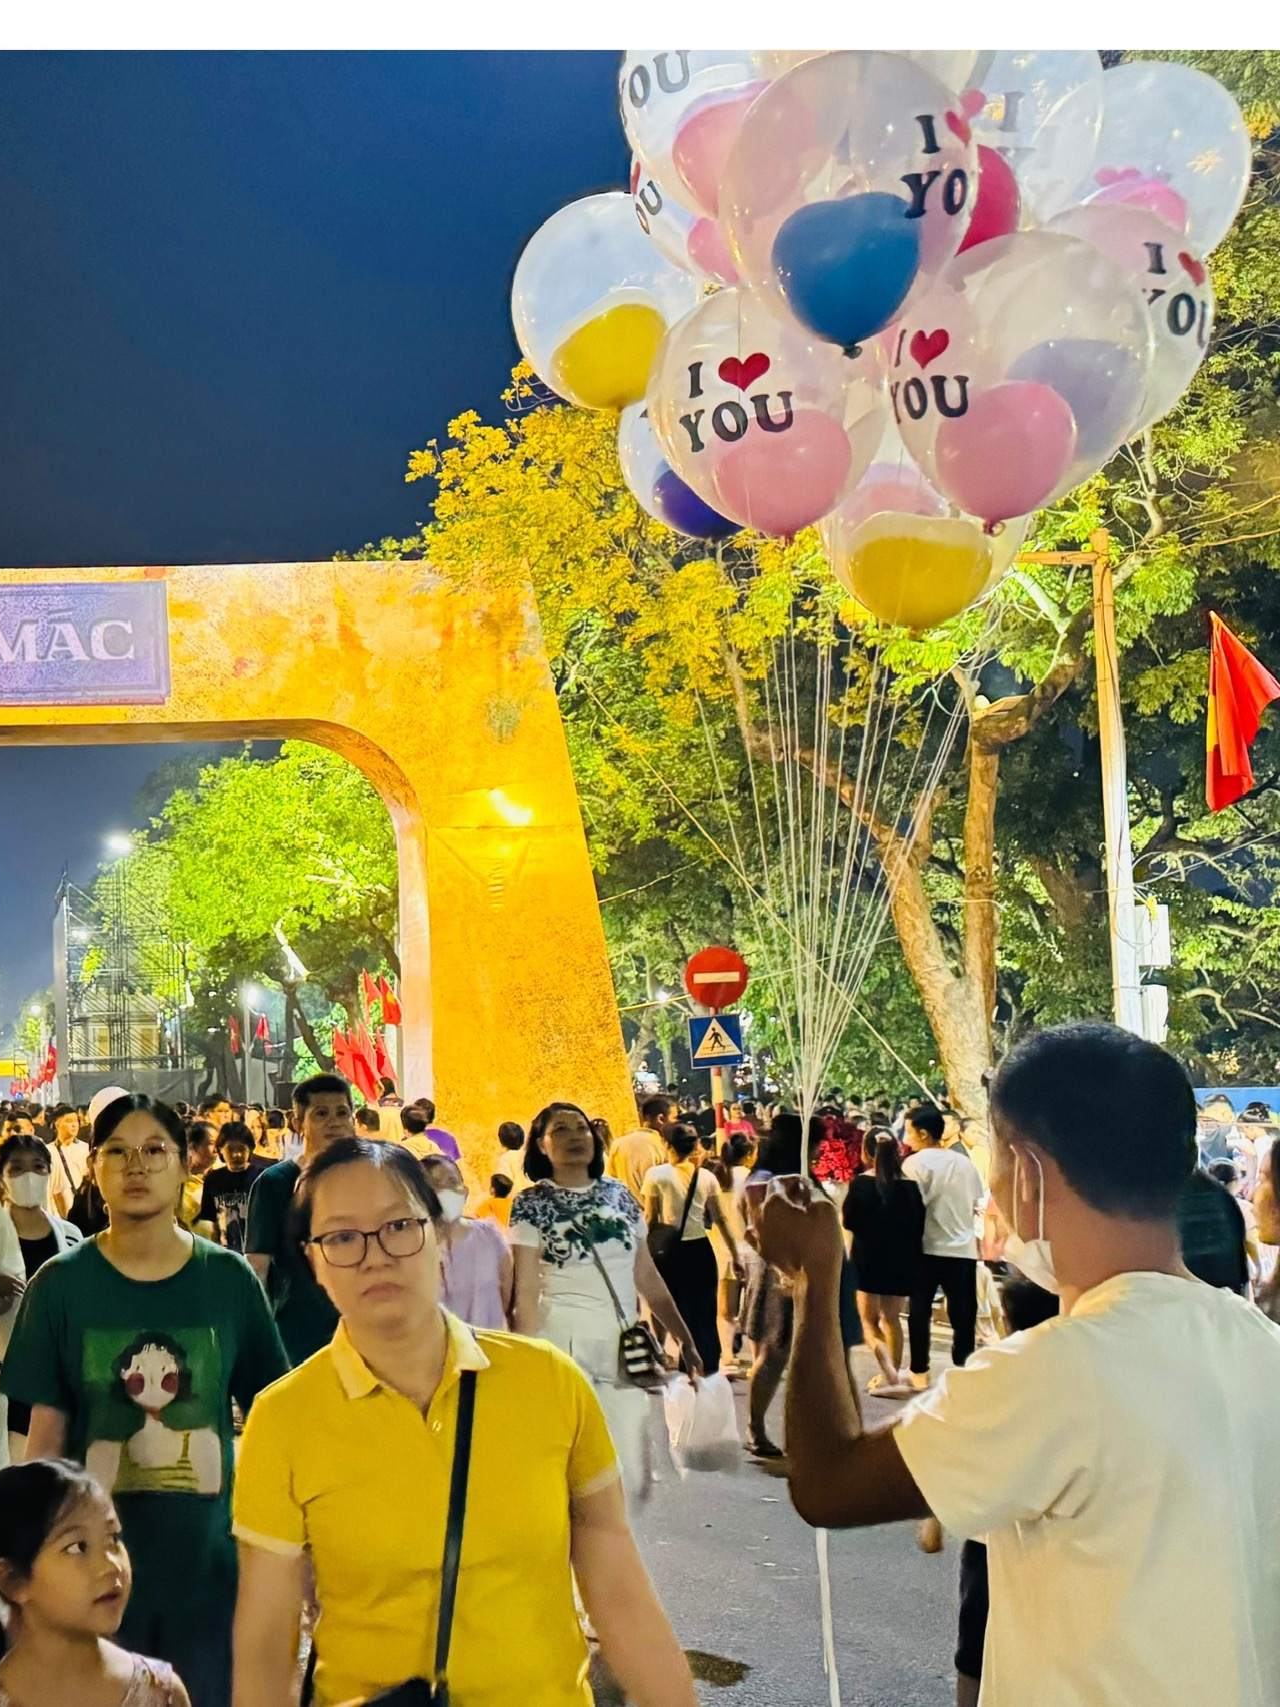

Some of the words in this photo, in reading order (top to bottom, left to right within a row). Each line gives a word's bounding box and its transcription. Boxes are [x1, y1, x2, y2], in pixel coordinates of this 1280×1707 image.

[621, 50, 690, 118] OU
[915, 114, 941, 154] I
[900, 168, 969, 219] YO
[1143, 242, 1167, 275] I
[688, 361, 704, 399] I
[890, 375, 970, 425] YOU
[679, 391, 794, 453] YOU
